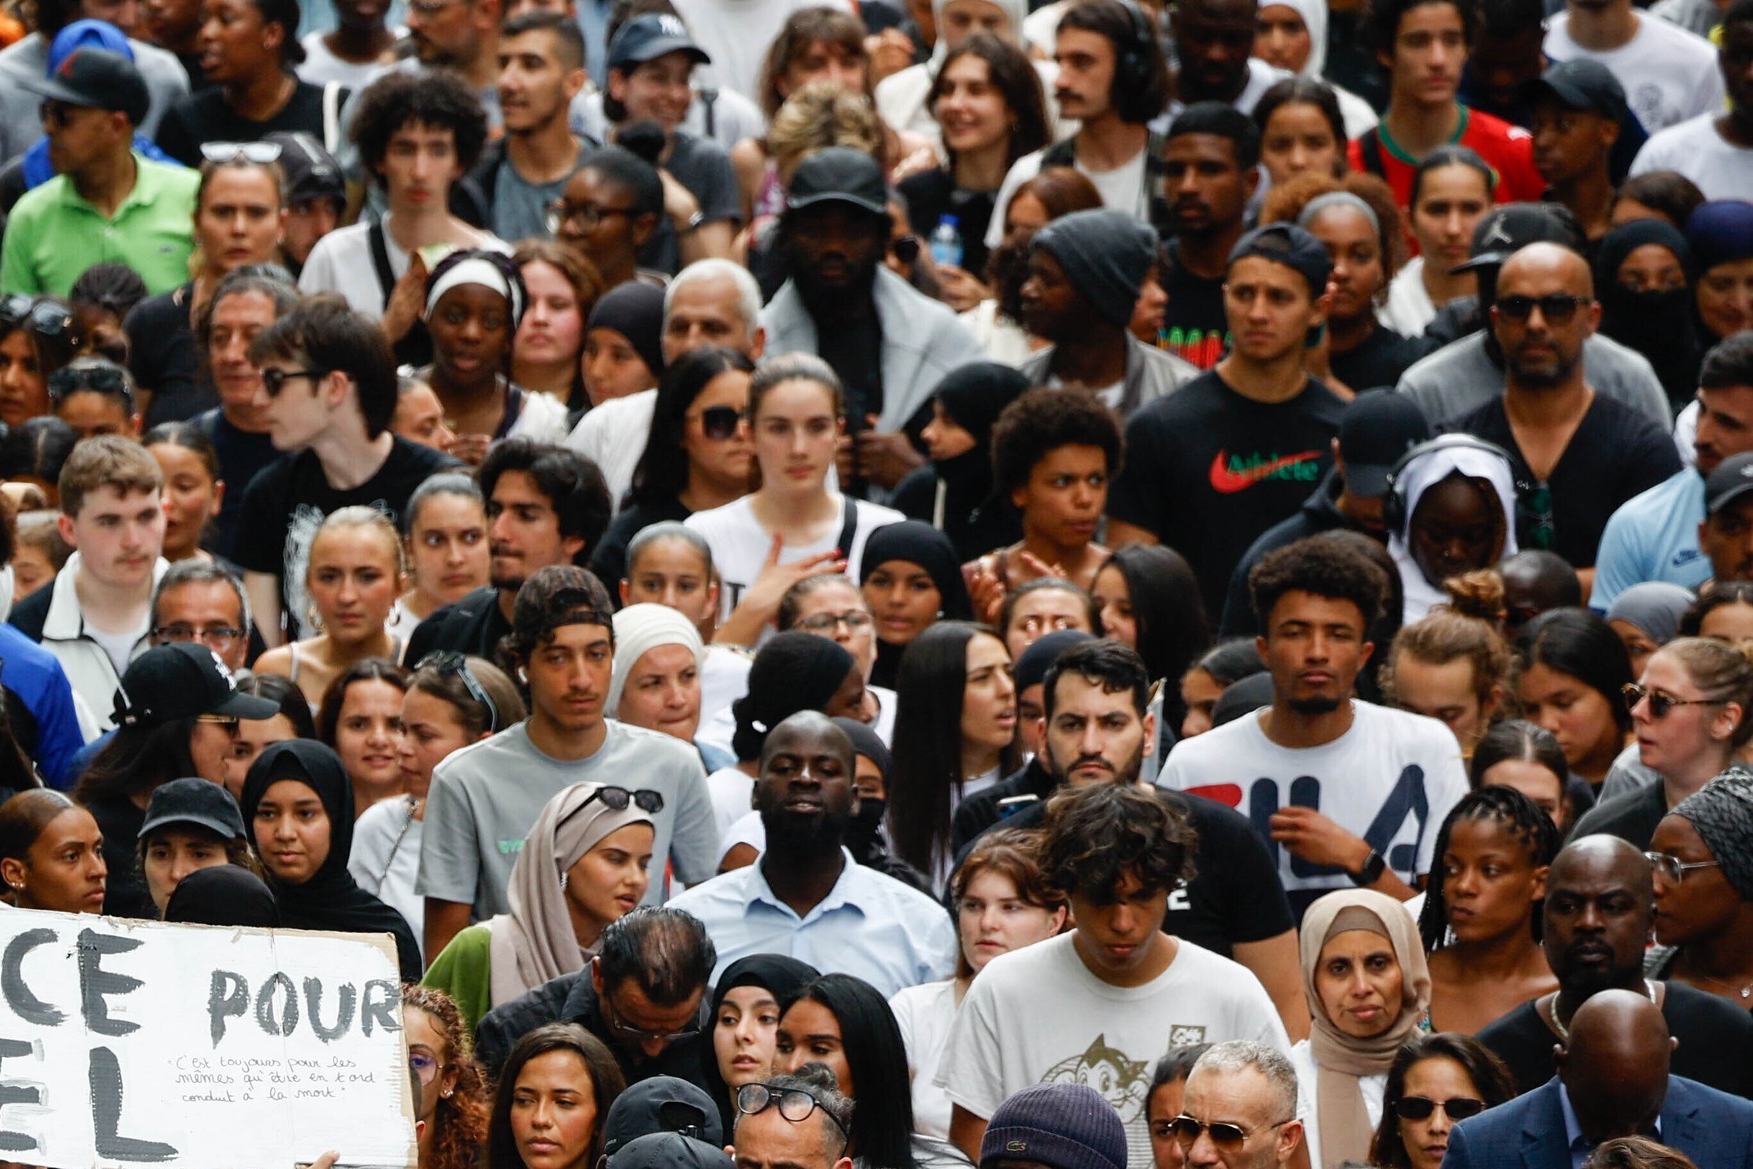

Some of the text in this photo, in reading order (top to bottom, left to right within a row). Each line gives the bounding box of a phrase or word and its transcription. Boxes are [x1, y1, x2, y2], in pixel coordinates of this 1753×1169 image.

[1182, 764, 1429, 879] ILA
[207, 968, 403, 1050] POUR
[220, 1056, 281, 1072] toujours
[288, 1058, 321, 1072] pour
[327, 1056, 356, 1068] les
[175, 1070, 234, 1084] mêmes
[310, 1073, 328, 1082] en
[182, 1090, 235, 1102] conduit
[267, 1087, 287, 1099] la
